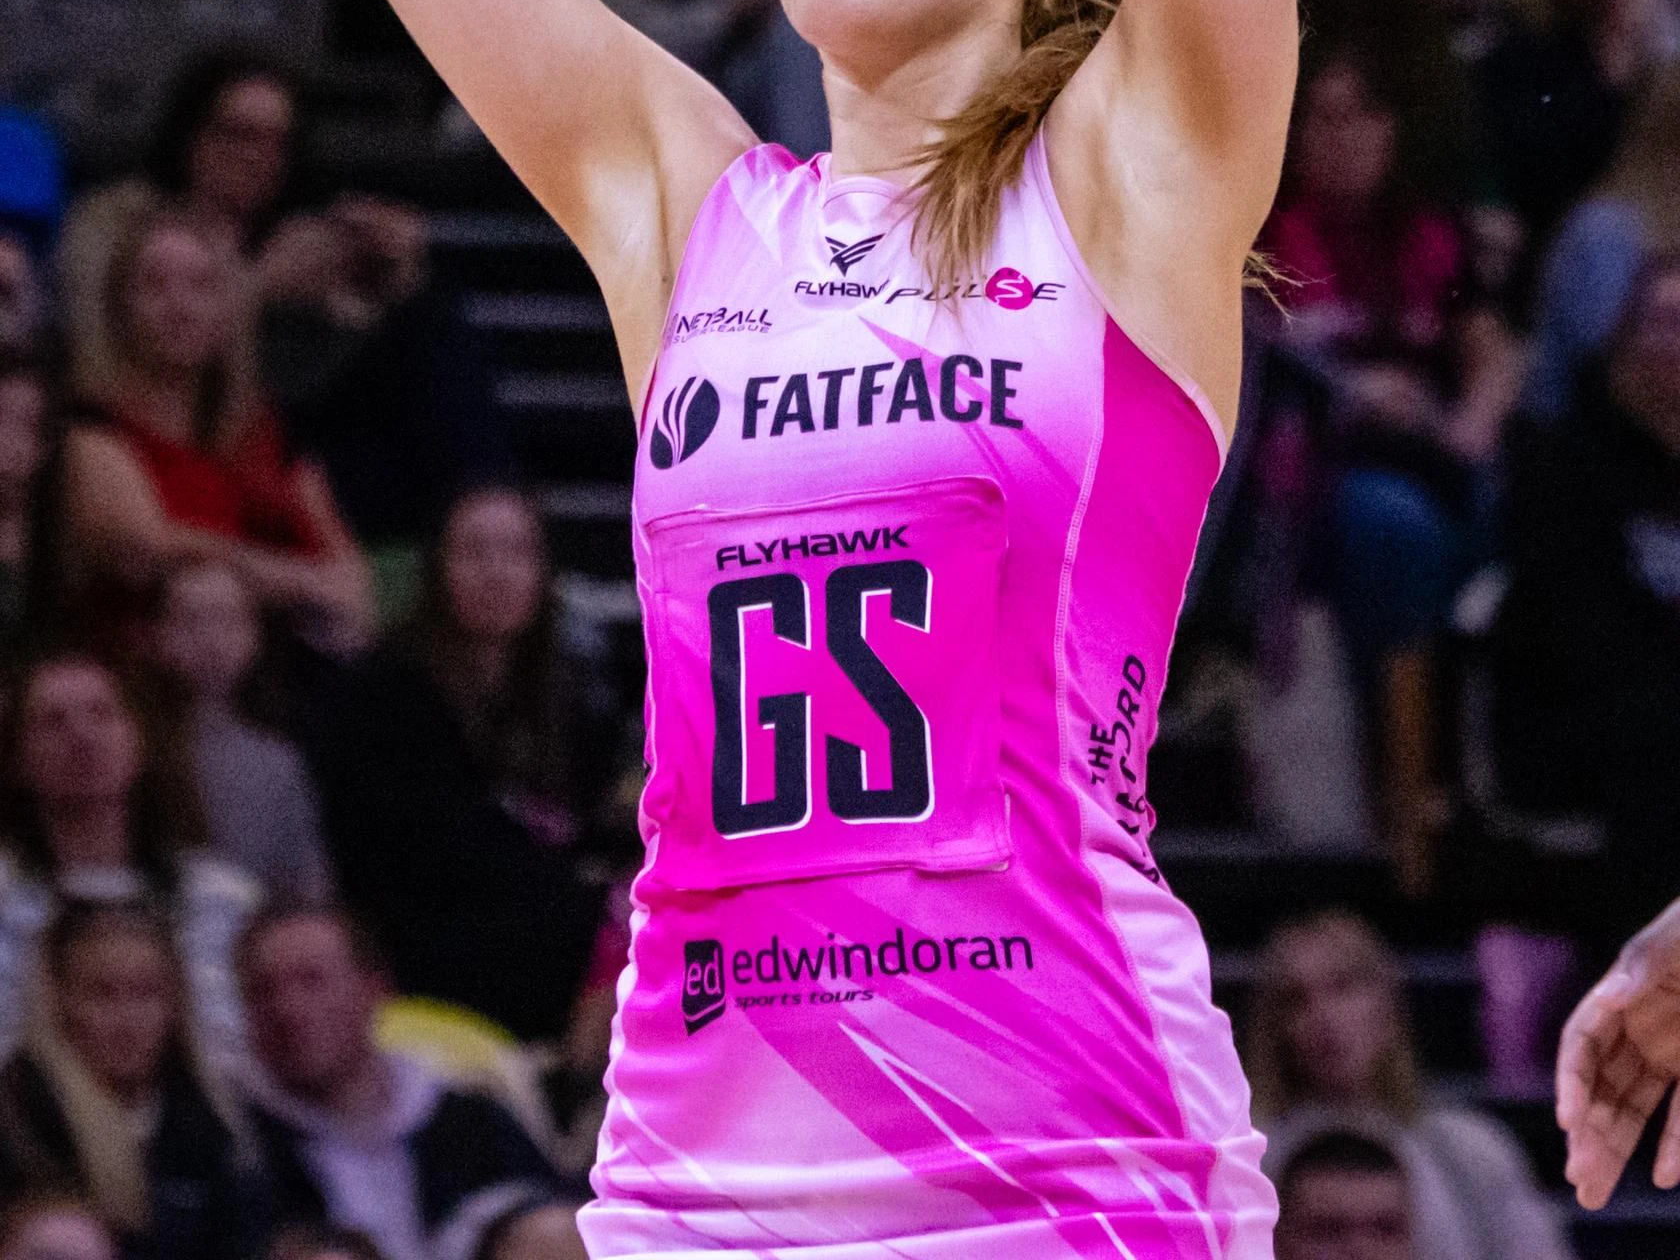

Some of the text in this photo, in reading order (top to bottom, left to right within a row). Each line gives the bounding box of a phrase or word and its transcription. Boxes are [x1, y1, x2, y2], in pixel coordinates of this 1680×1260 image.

[676, 307, 772, 334] NETBALL
[741, 354, 1024, 440] FATFACE
[707, 559, 933, 840] GS
[1088, 723, 1114, 785] THE
[686, 948, 722, 996] ed
[732, 929, 1035, 985] edwindoran
[735, 989, 874, 1010] sports tours
